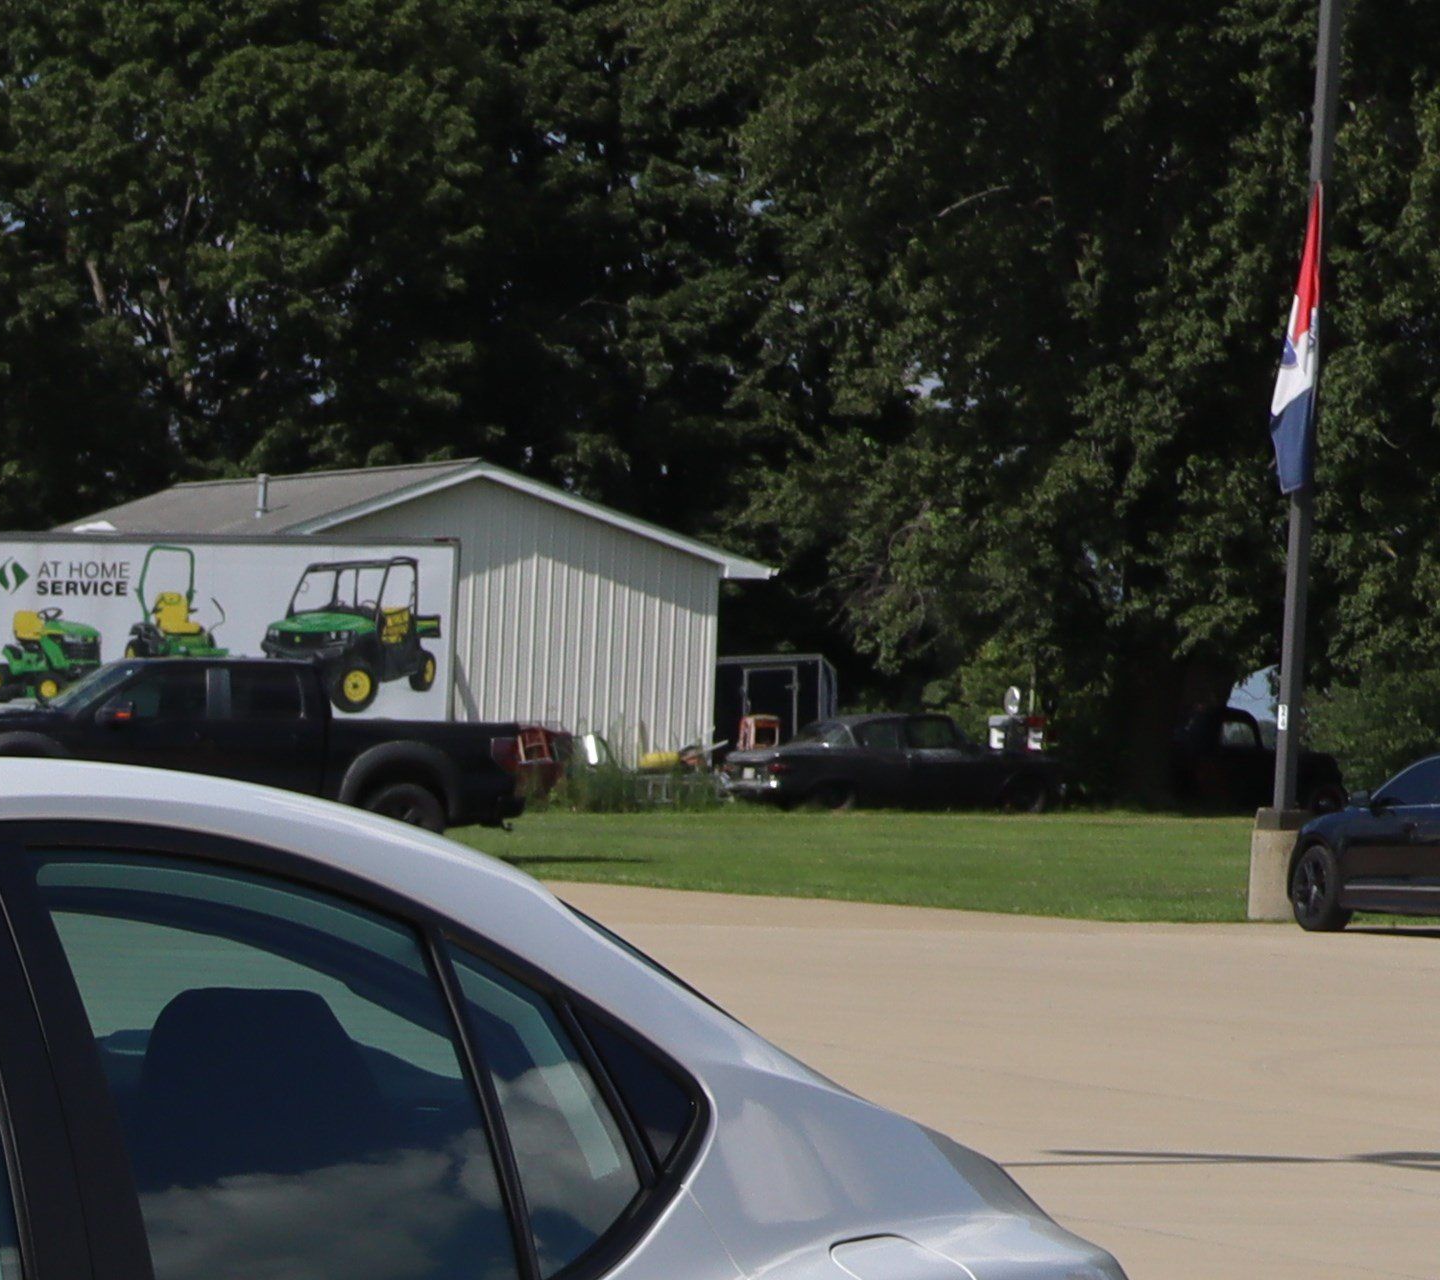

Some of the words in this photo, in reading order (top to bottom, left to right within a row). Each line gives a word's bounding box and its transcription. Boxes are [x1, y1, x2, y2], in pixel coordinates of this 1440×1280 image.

[38, 561, 63, 579] AT
[68, 561, 130, 580] HOME
[36, 581, 129, 597] SERVICE
